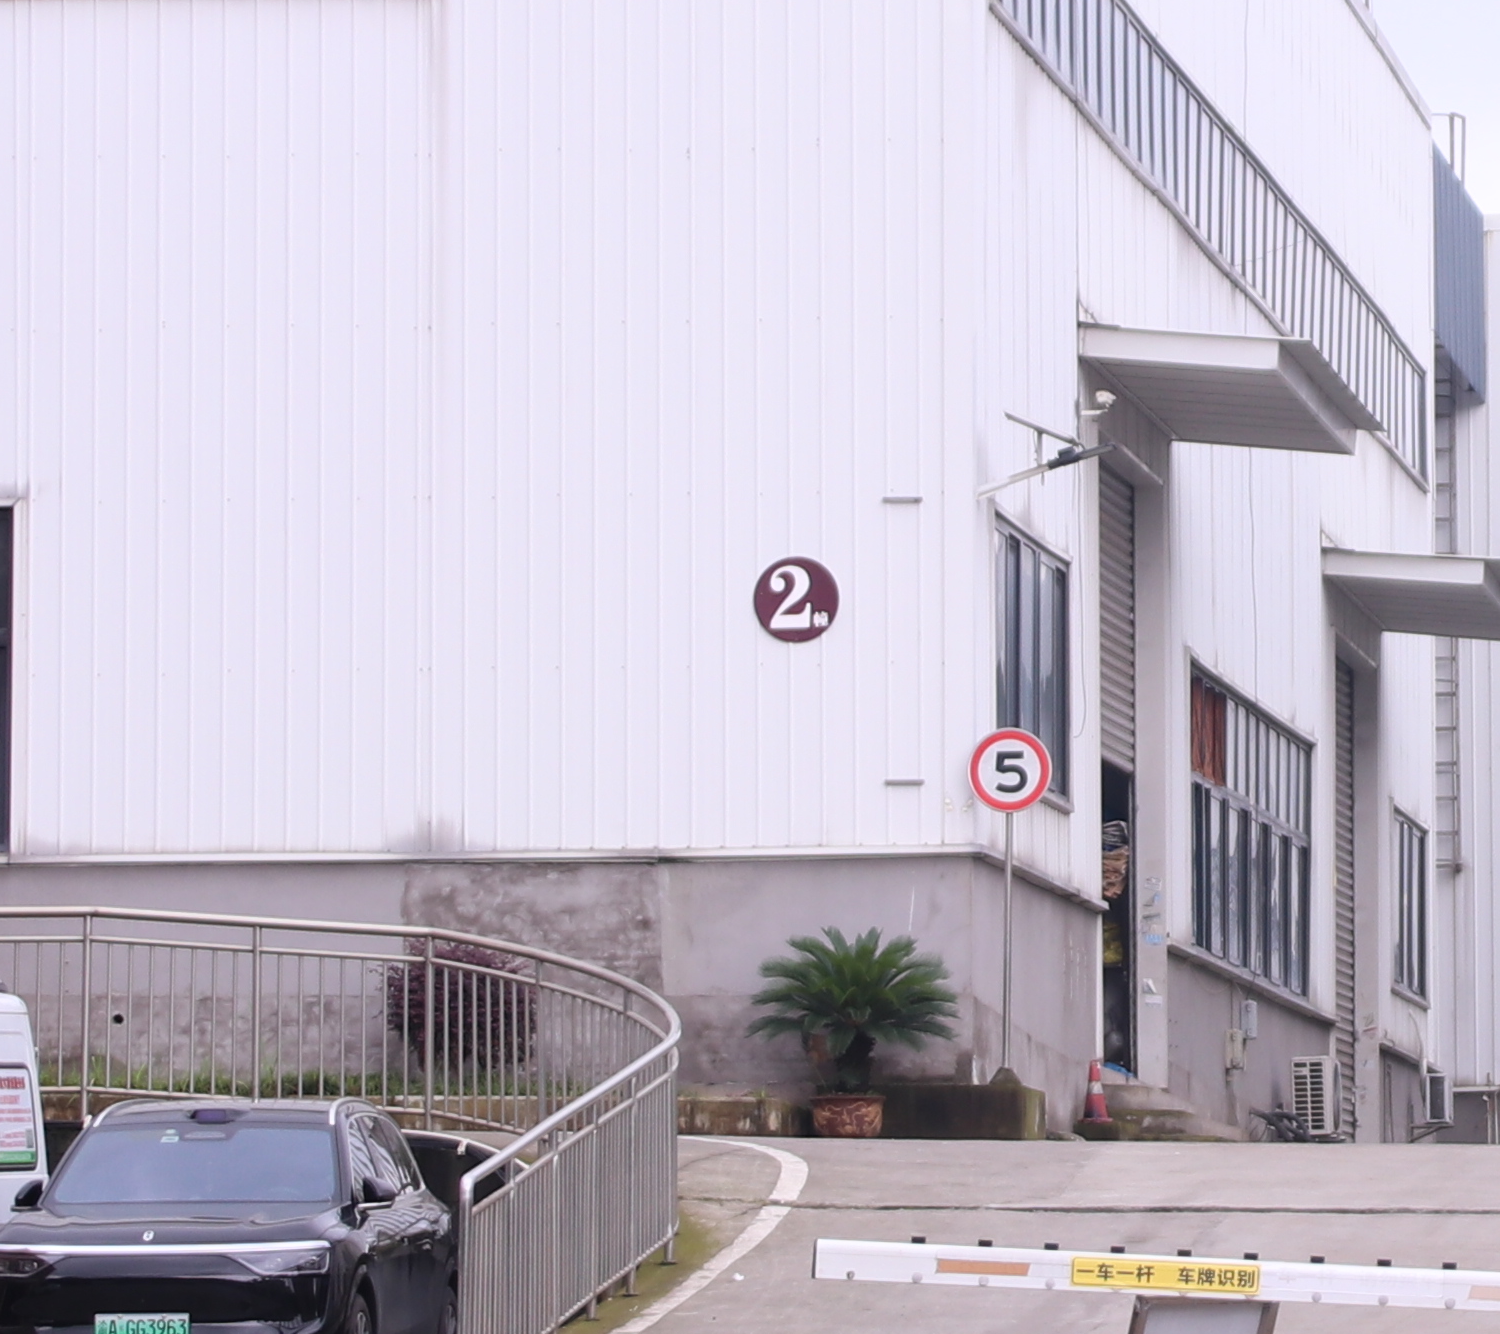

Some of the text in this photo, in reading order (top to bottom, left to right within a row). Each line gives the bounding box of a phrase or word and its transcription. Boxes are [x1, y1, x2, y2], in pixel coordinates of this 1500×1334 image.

[994, 750, 1028, 794] 5
[1076, 1263, 1256, 1289] 一车一杆 车牌识别
